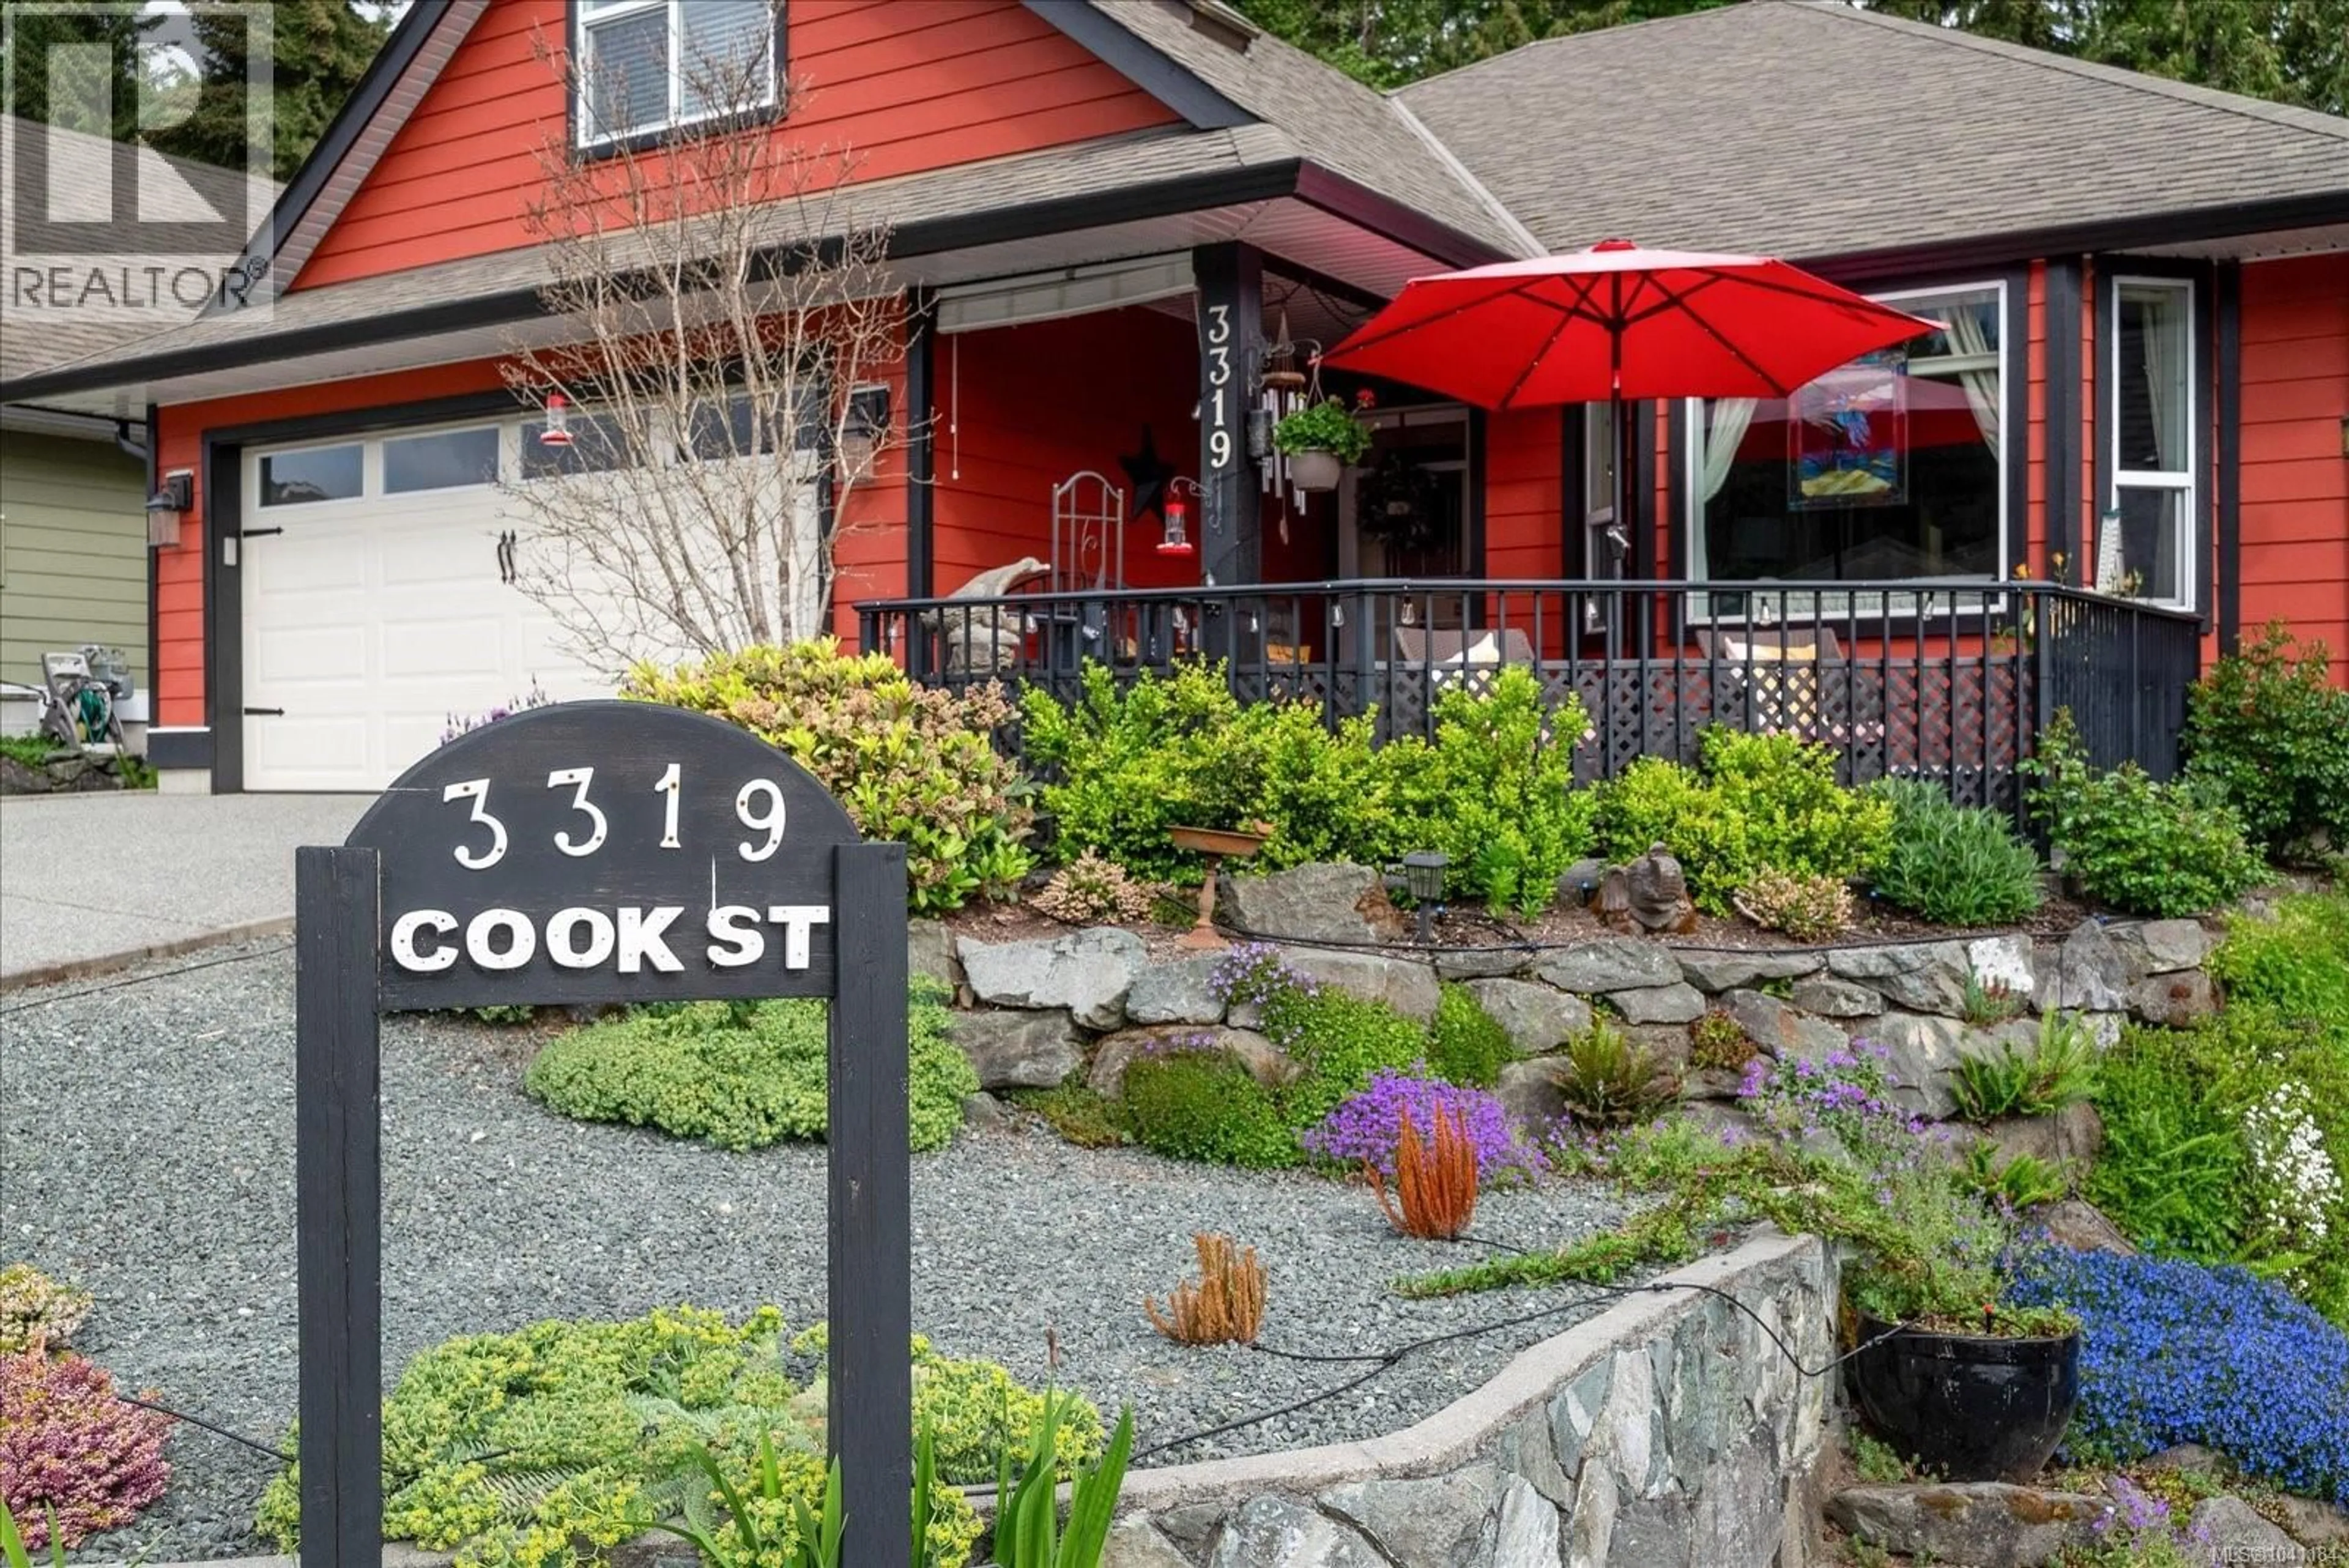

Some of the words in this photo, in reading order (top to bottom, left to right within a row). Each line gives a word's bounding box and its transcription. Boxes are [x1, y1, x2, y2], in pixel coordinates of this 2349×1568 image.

[1208, 305, 1231, 468] 3319
[390, 906, 685, 973] COOK
[707, 905, 830, 970] ST
